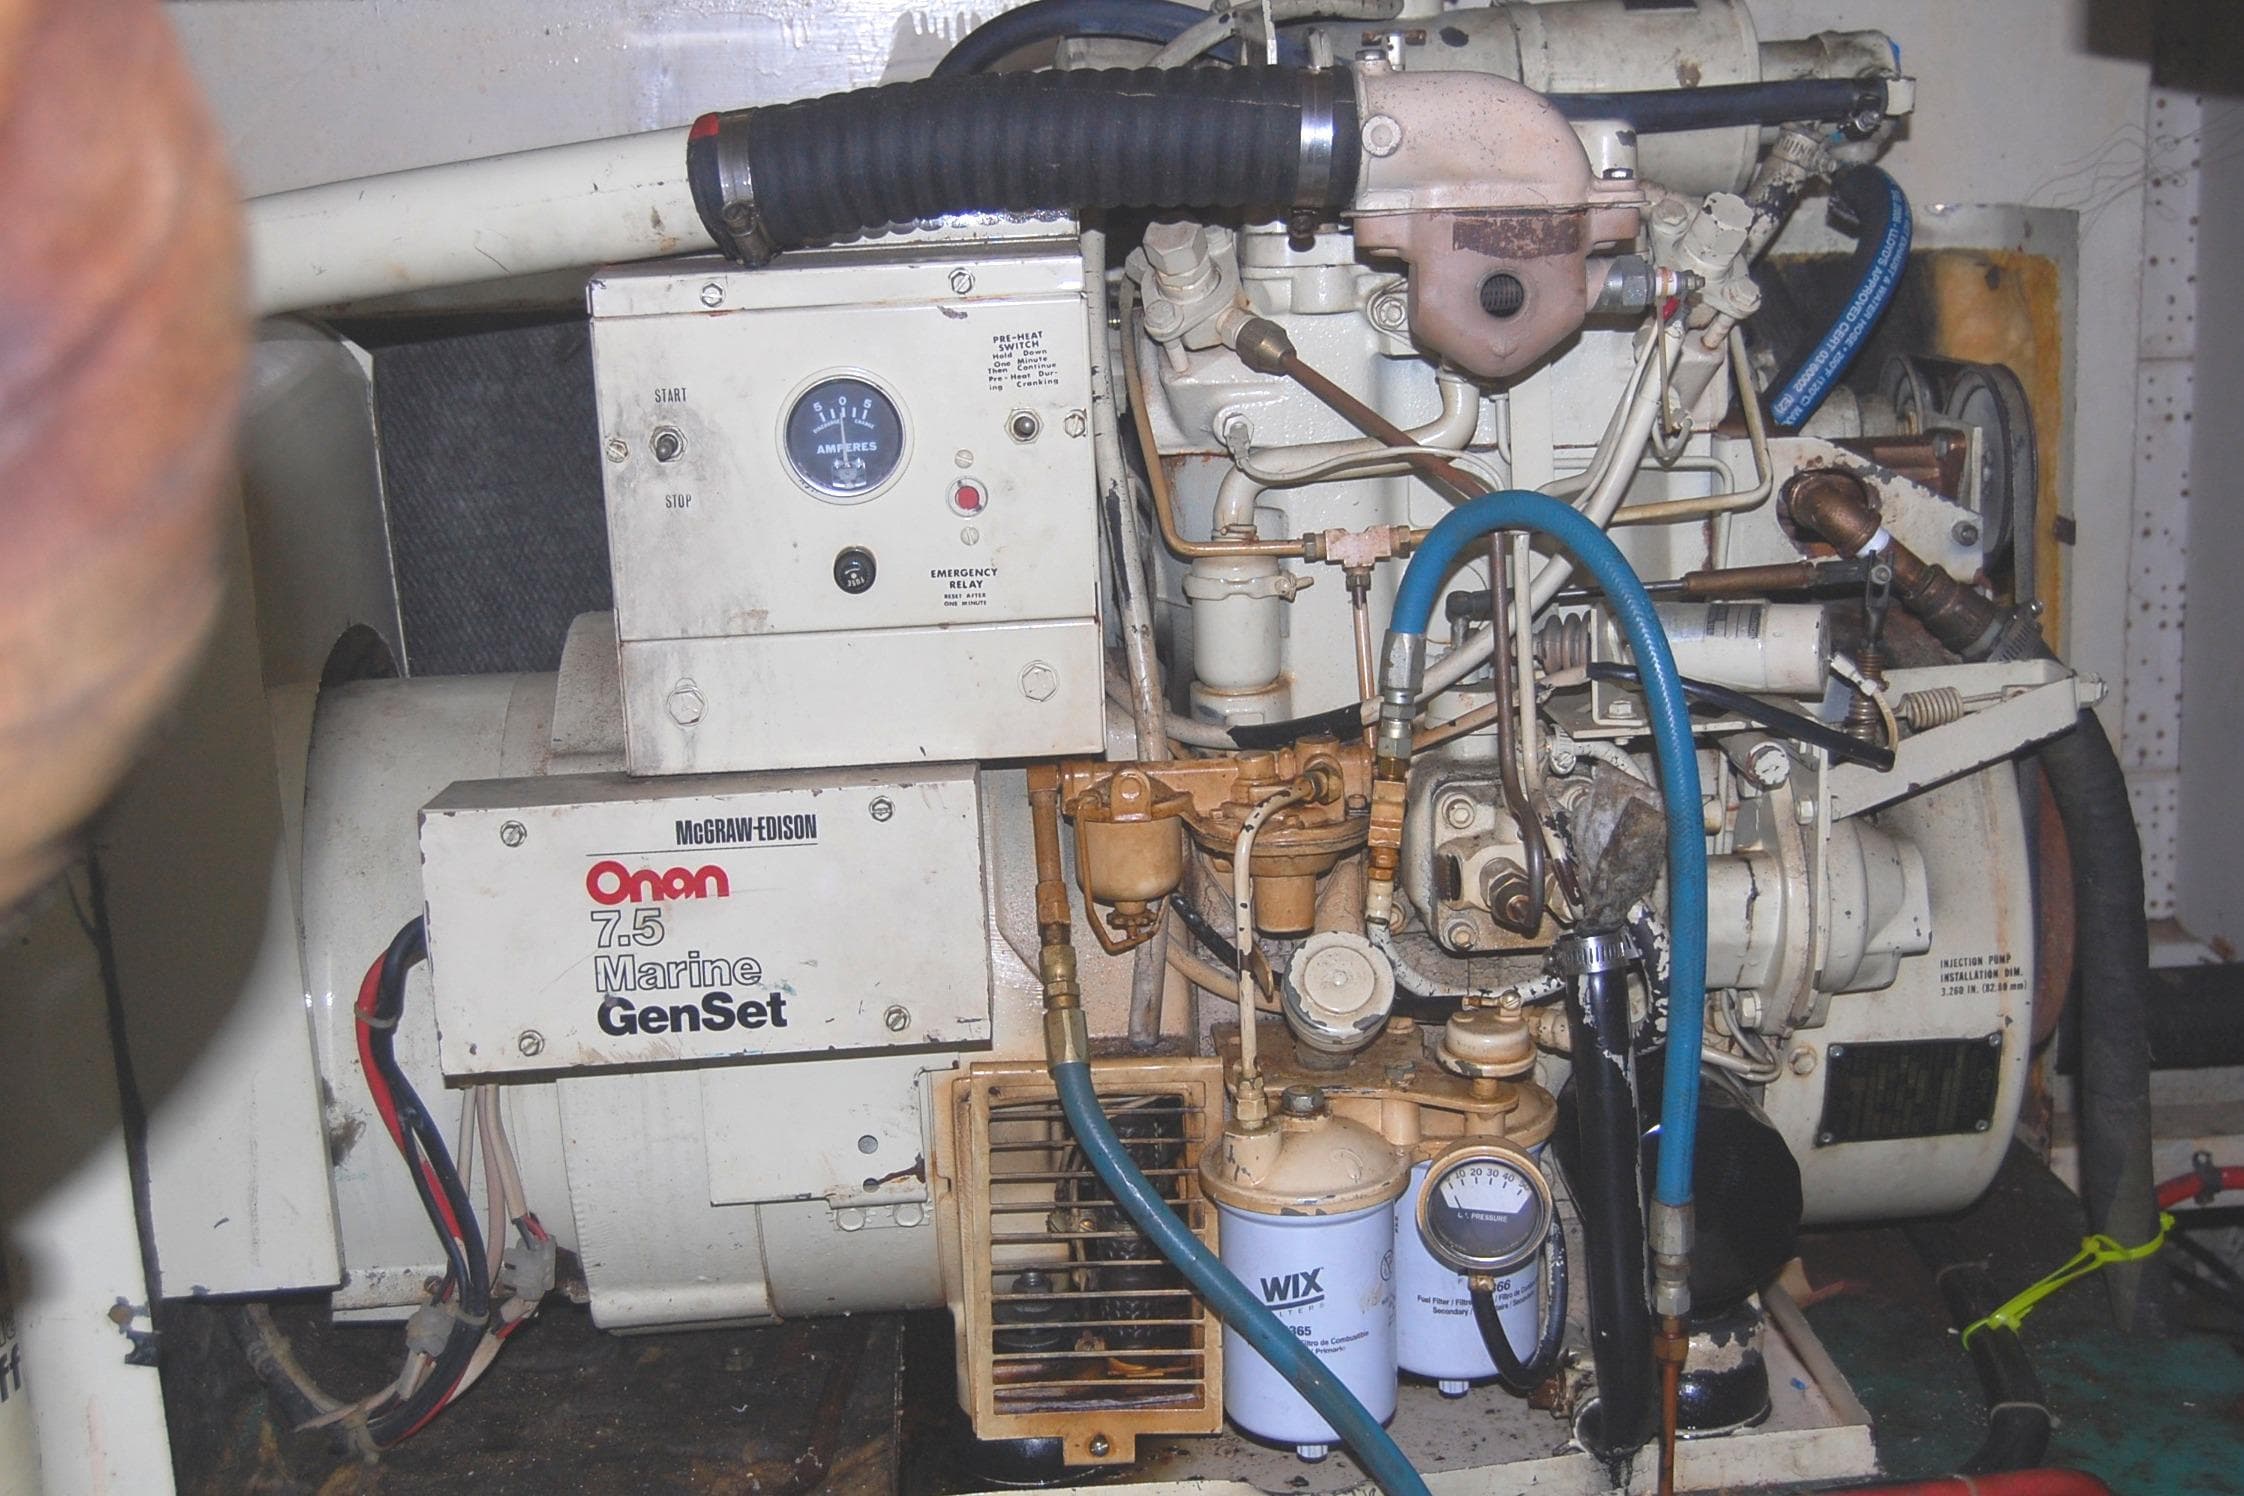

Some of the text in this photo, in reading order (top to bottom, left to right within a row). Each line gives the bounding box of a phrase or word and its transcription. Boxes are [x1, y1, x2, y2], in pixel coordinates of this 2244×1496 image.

[1886, 235, 1907, 277] EXHAUST
[1882, 275, 1893, 285] &
[1844, 265, 1883, 322] APPROVED
[1862, 284, 1888, 319] WATER
[993, 330, 1042, 343] PRE-HEAT
[1824, 320, 1850, 351] CERT
[1842, 318, 1868, 347] HOSE
[999, 341, 1039, 352] SWITCH
[992, 352, 1012, 360] Hold
[1017, 363, 1056, 371] Continue
[1017, 379, 1058, 388] Cranking
[655, 387, 687, 403] START
[813, 396, 872, 412] 5 0 5
[817, 442, 877, 454] AMPERES
[666, 494, 691, 508] STOP
[931, 568, 997, 578] EMERGENCY
[950, 580, 983, 589] RELAY
[586, 860, 730, 905] Onan
[591, 908, 665, 948] 7.5
[1940, 953, 2011, 968] INJECTION PUMP
[595, 951, 762, 992] Marine
[1940, 967, 2023, 983] INSTALLATION DIM.
[598, 991, 787, 1037] GenSet
[1455, 1170, 1465, 1179] 10
[1470, 1168, 1482, 1176] 20
[1487, 1168, 1499, 1177] 30
[1503, 1173, 1514, 1182] 40
[1471, 1213, 1507, 1222] PRESSURE
[1260, 1267, 1324, 1303] WIX
[1417, 1294, 1430, 1304] Fuel
[1433, 1297, 1449, 1305] Filter
[1433, 1307, 1469, 1316] Secondary
